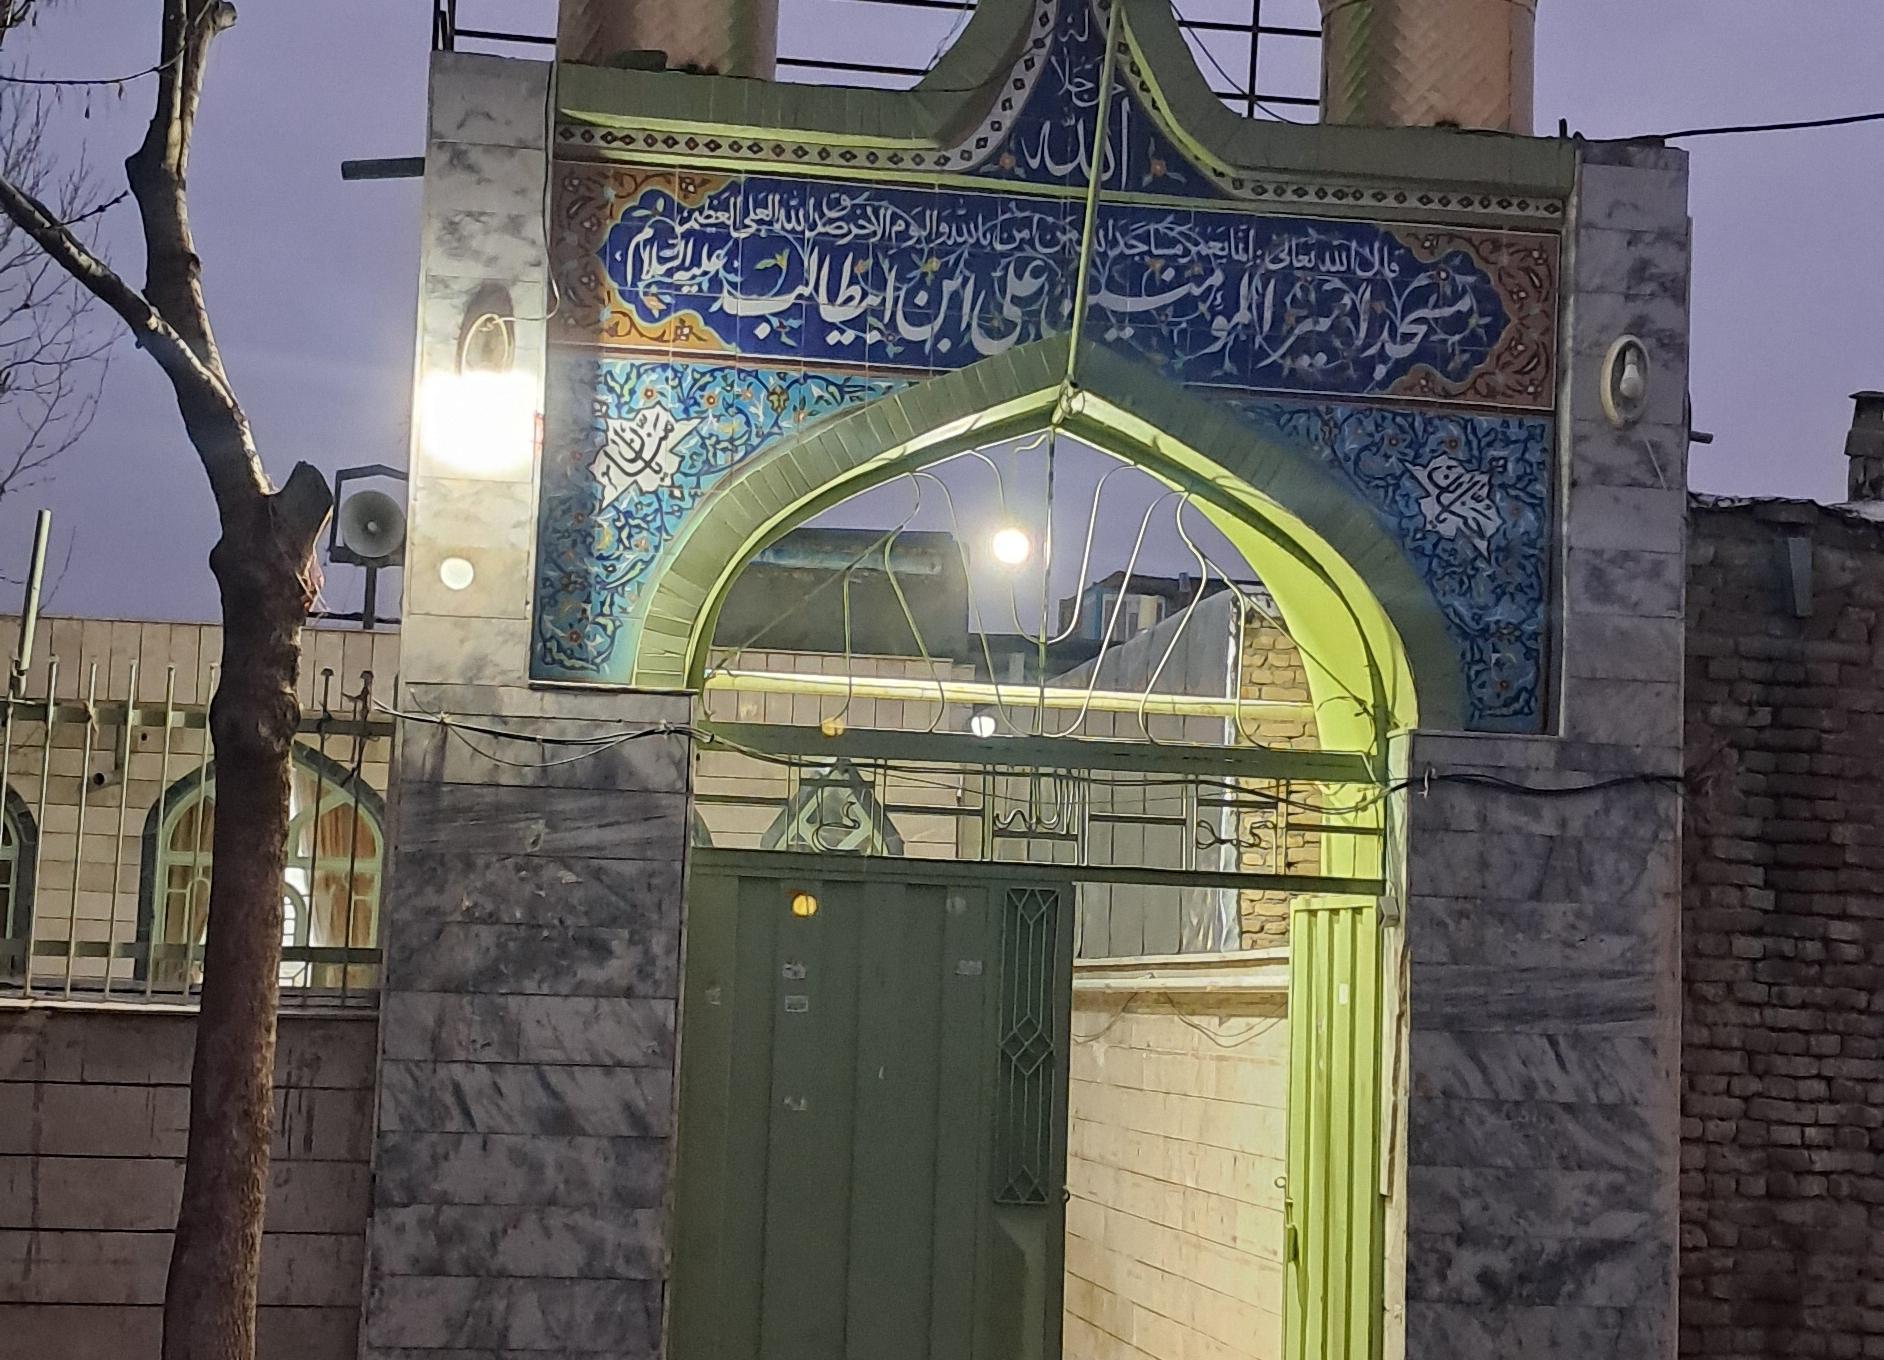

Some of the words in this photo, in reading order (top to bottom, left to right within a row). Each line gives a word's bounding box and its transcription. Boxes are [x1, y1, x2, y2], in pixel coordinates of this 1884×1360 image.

[1021, 96, 1131, 191] الله
[626, 227, 694, 289] السلام
[672, 242, 728, 294] علیه
[1318, 240, 1356, 273] الله
[1356, 240, 1404, 278] قال
[896, 271, 975, 354] ابن
[971, 259, 1048, 356] علی
[1360, 292, 1472, 380] مسجد
